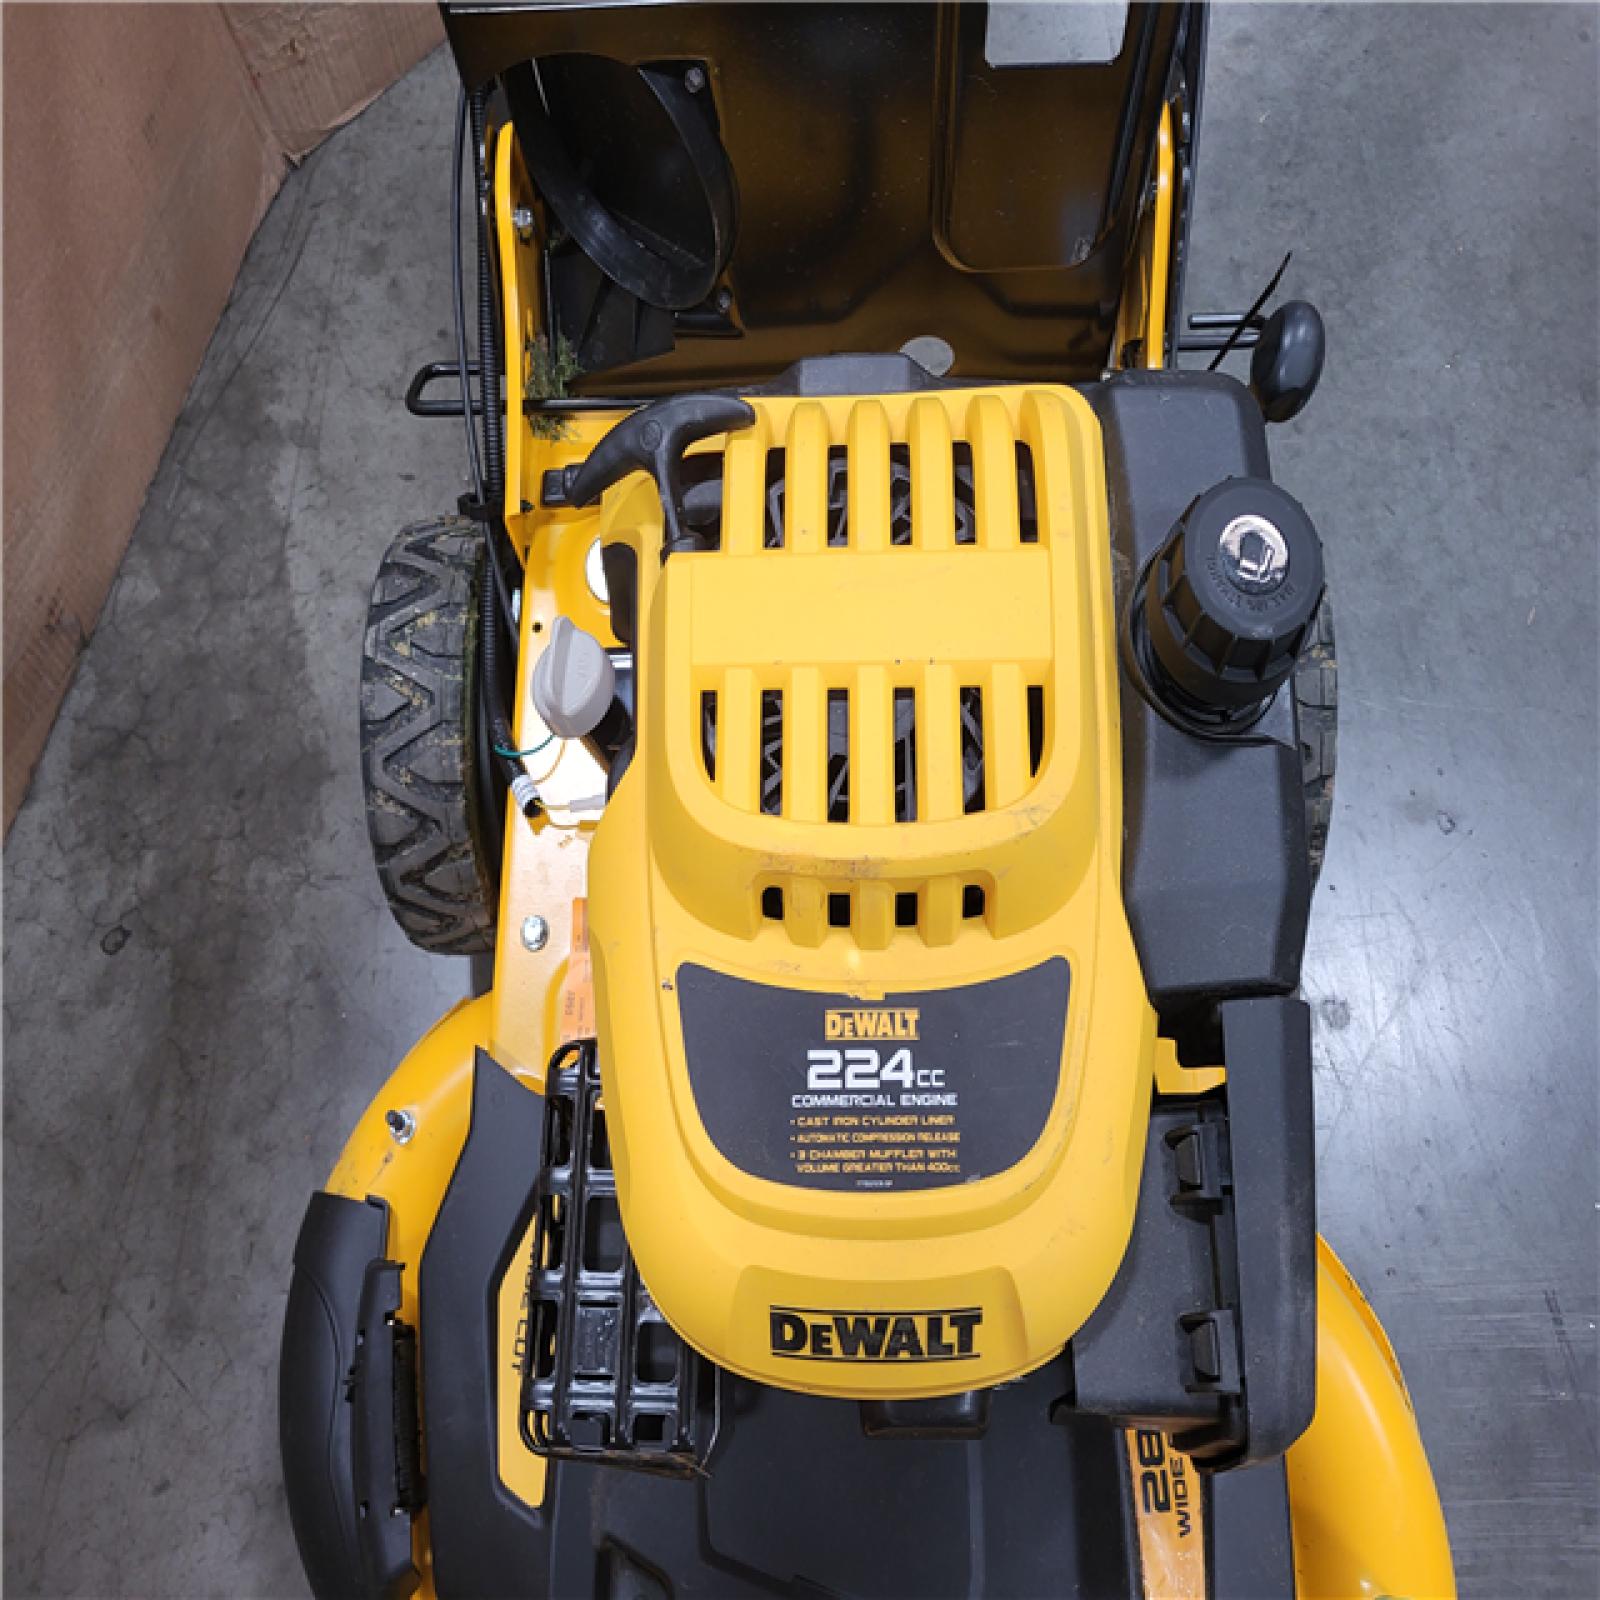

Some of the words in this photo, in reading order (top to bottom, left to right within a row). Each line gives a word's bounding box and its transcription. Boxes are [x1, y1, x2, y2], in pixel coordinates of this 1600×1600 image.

[792, 1094, 896, 1108] COMMERCIAL
[900, 1092, 958, 1106] ENGINE
[797, 1115, 831, 1126] CAST
[832, 1115, 859, 1126] IRON
[862, 1115, 918, 1126] CYLINDER
[921, 1114, 955, 1126] LINER
[797, 1132, 850, 1143] AUTOMATIC
[852, 1132, 916, 1143] COMPRESSION
[917, 1132, 961, 1143] RELEASE
[809, 1149, 865, 1160] CHAMBER
[869, 1149, 924, 1160] MUFFLER
[926, 1149, 957, 1160] WITH
[796, 1162, 840, 1173] VOLUME
[842, 1162, 893, 1173] GREATER
[894, 1162, 926, 1173] THAN
[1170, 1457, 1191, 1538] WIDE
